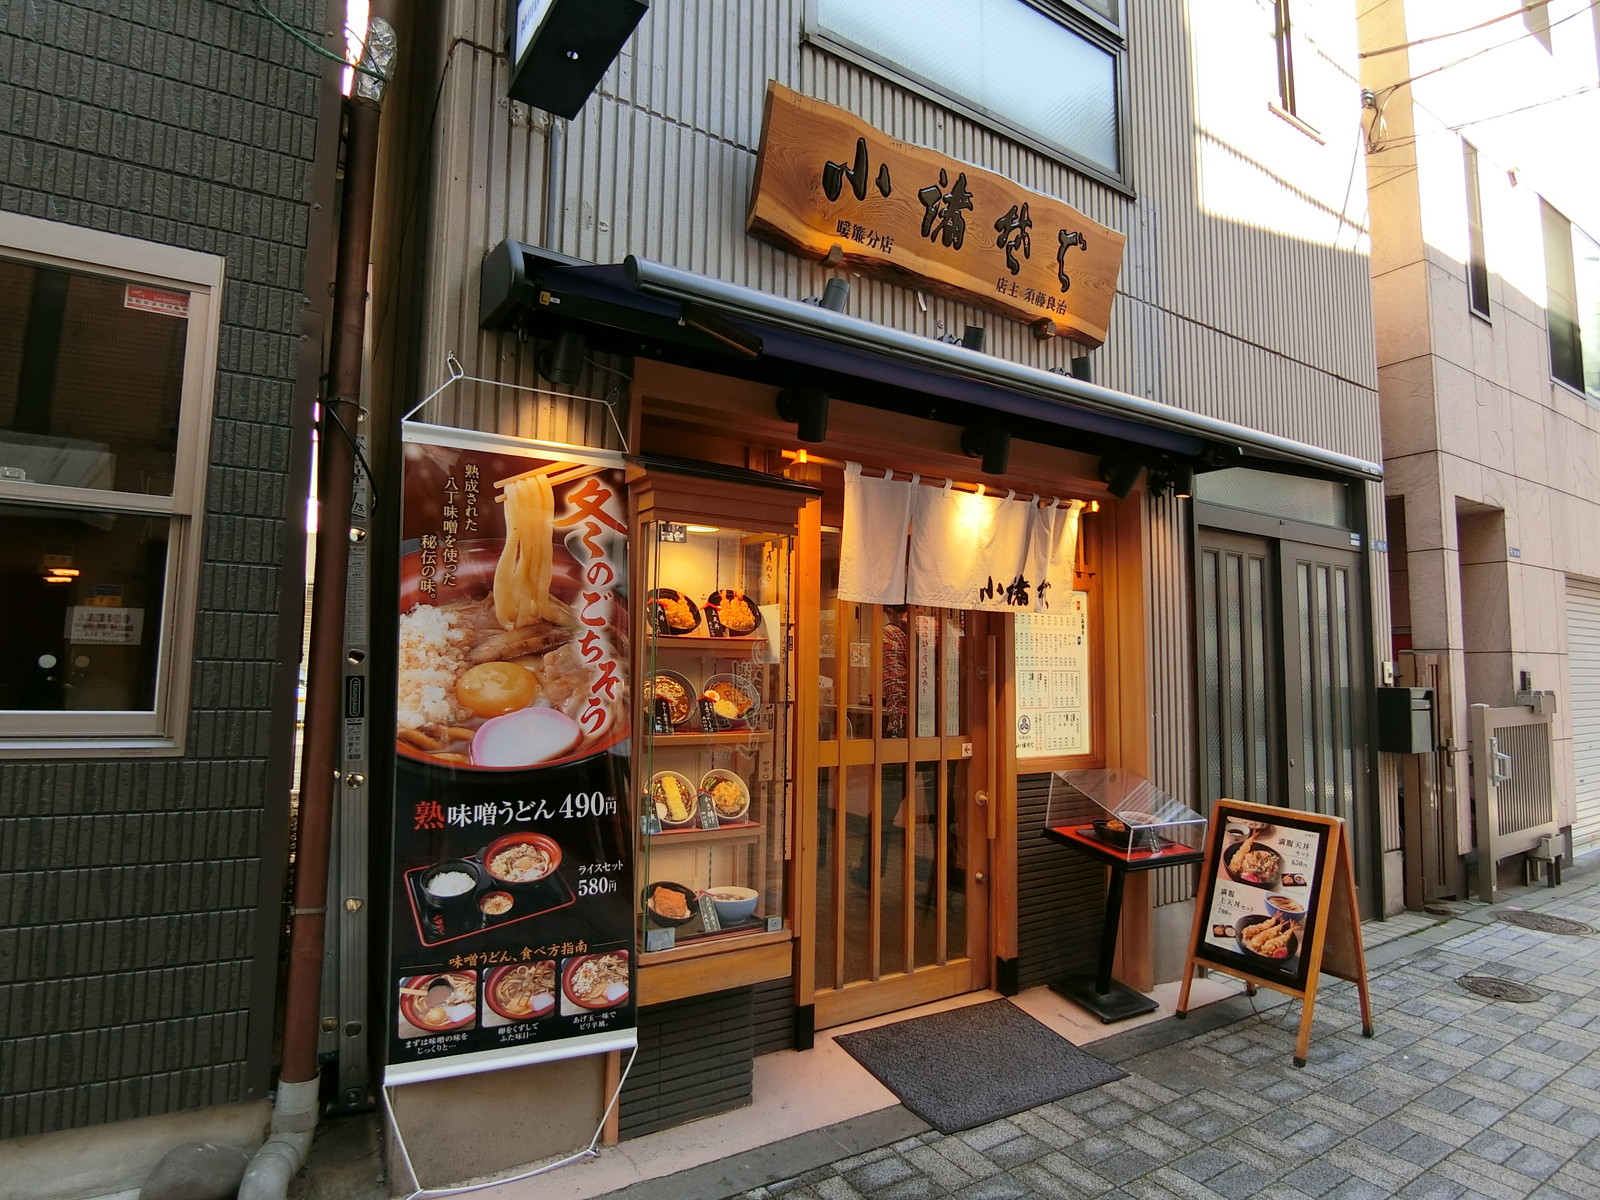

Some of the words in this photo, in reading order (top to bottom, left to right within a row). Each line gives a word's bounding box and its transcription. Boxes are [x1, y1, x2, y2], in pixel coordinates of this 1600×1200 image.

[837, 219, 895, 255] 暖簾分店
[995, 277, 1018, 299] 店主
[1023, 286, 1068, 316] 須藤良治
[464, 463, 480, 533] 熟成された
[442, 475, 459, 587] 八丁味噌を使った
[420, 534, 437, 599] 秘伝の味。
[550, 478, 628, 735] 冬のごちそう
[577, 876, 617, 897] 580円
[578, 859, 625, 876] ライスセット
[448, 940, 588, 969] 味噌うどん、食べ方指南
